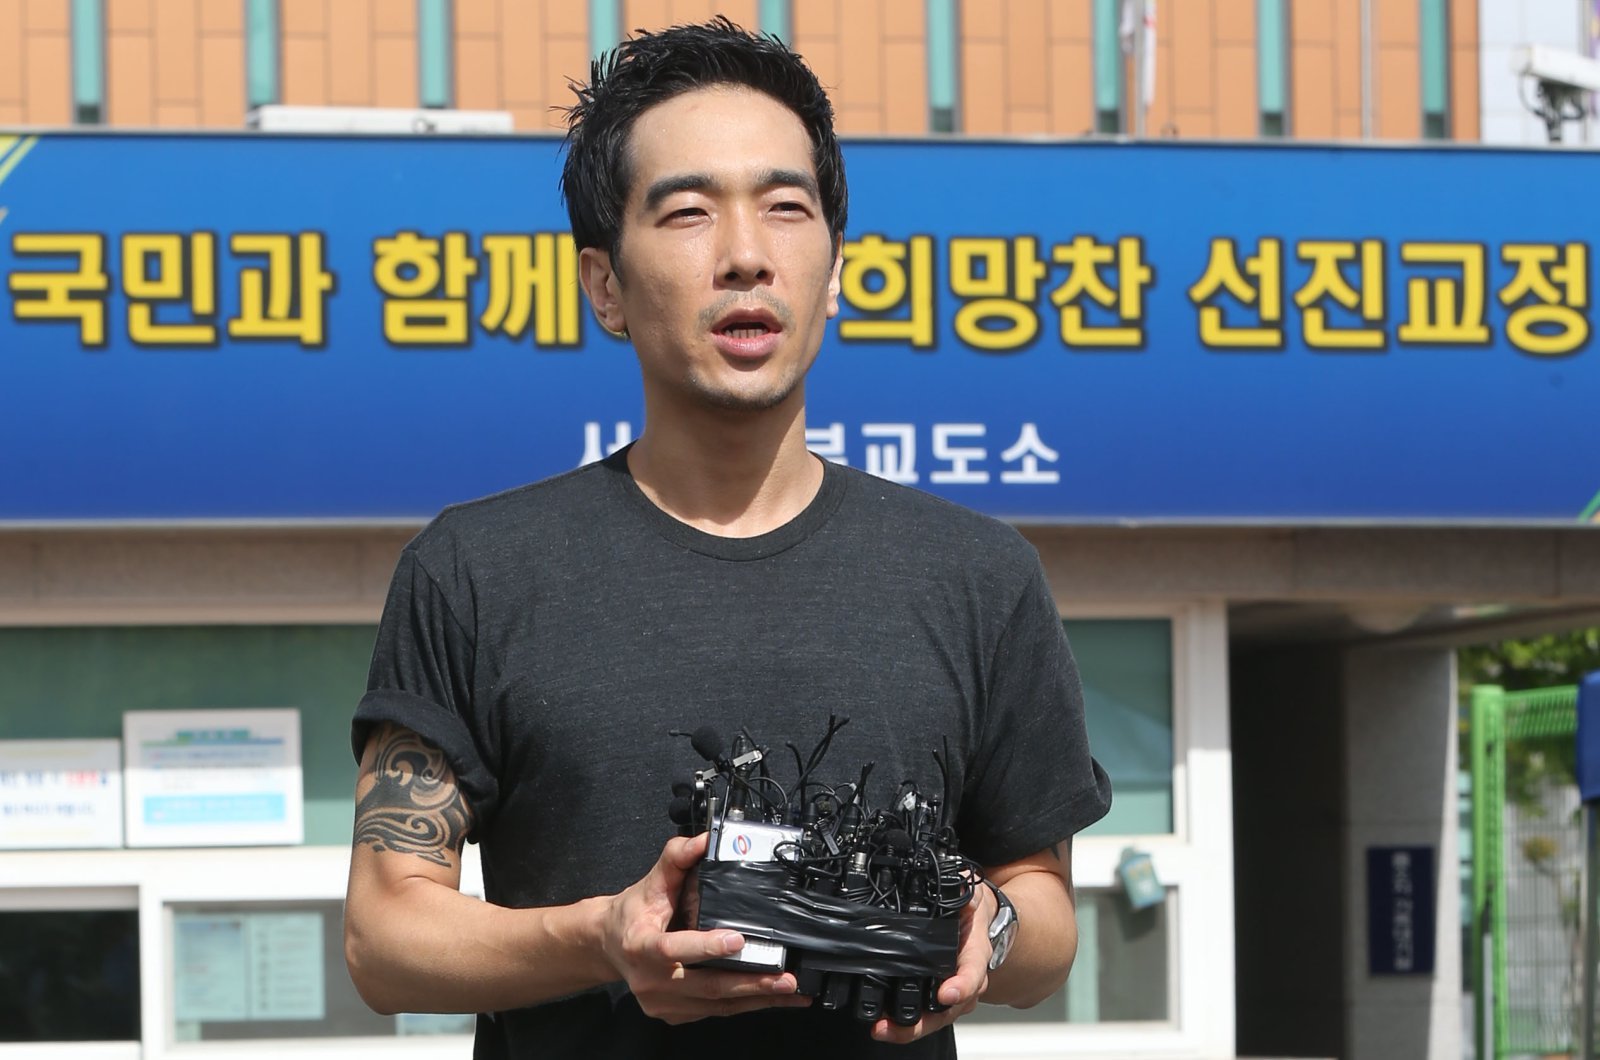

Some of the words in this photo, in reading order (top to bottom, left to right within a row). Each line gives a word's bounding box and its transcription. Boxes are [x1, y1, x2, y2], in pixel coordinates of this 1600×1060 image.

[9, 233, 333, 344] 국민과
[374, 233, 627, 344] 함께
[839, 236, 1151, 348] 희망찬
[1188, 238, 1590, 353] 선진교정
